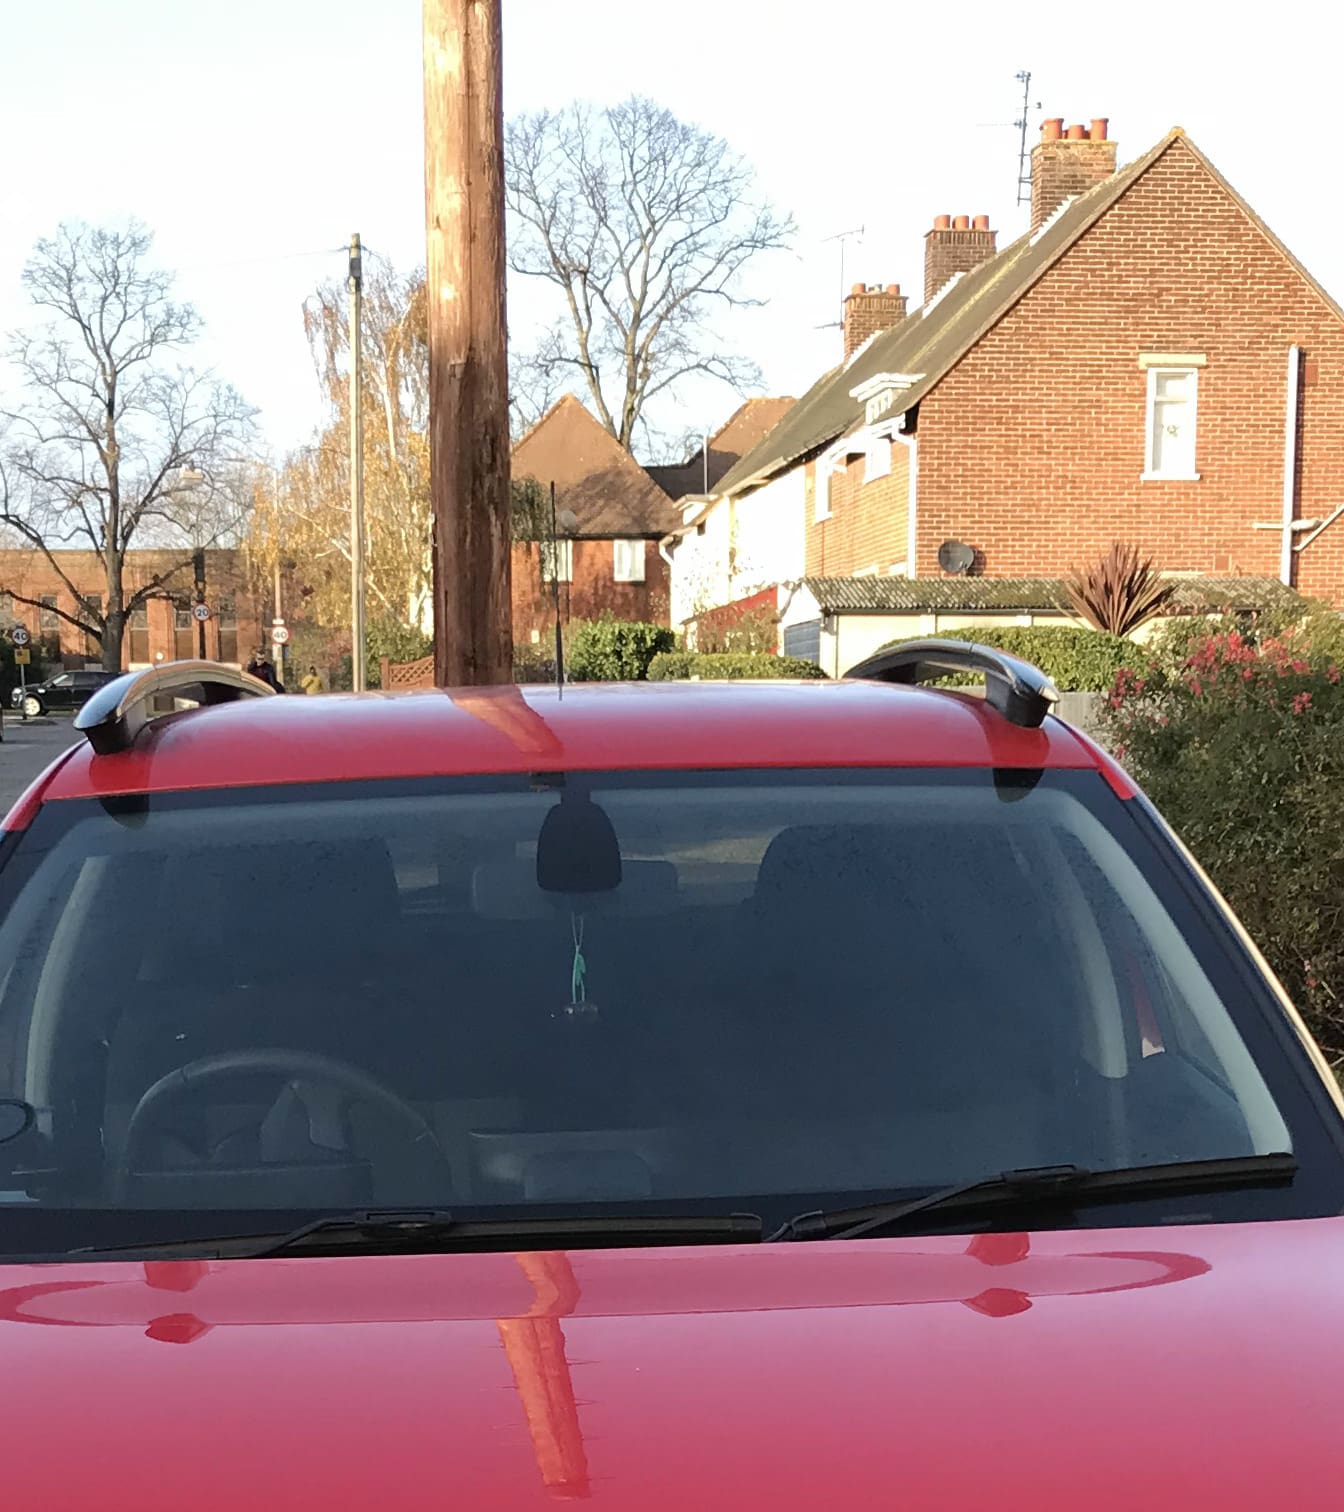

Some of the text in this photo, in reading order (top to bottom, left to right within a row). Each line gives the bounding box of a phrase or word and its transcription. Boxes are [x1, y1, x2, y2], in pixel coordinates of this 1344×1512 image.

[196, 608, 209, 617] 20
[14, 631, 27, 640] 40
[273, 630, 287, 639] 40
